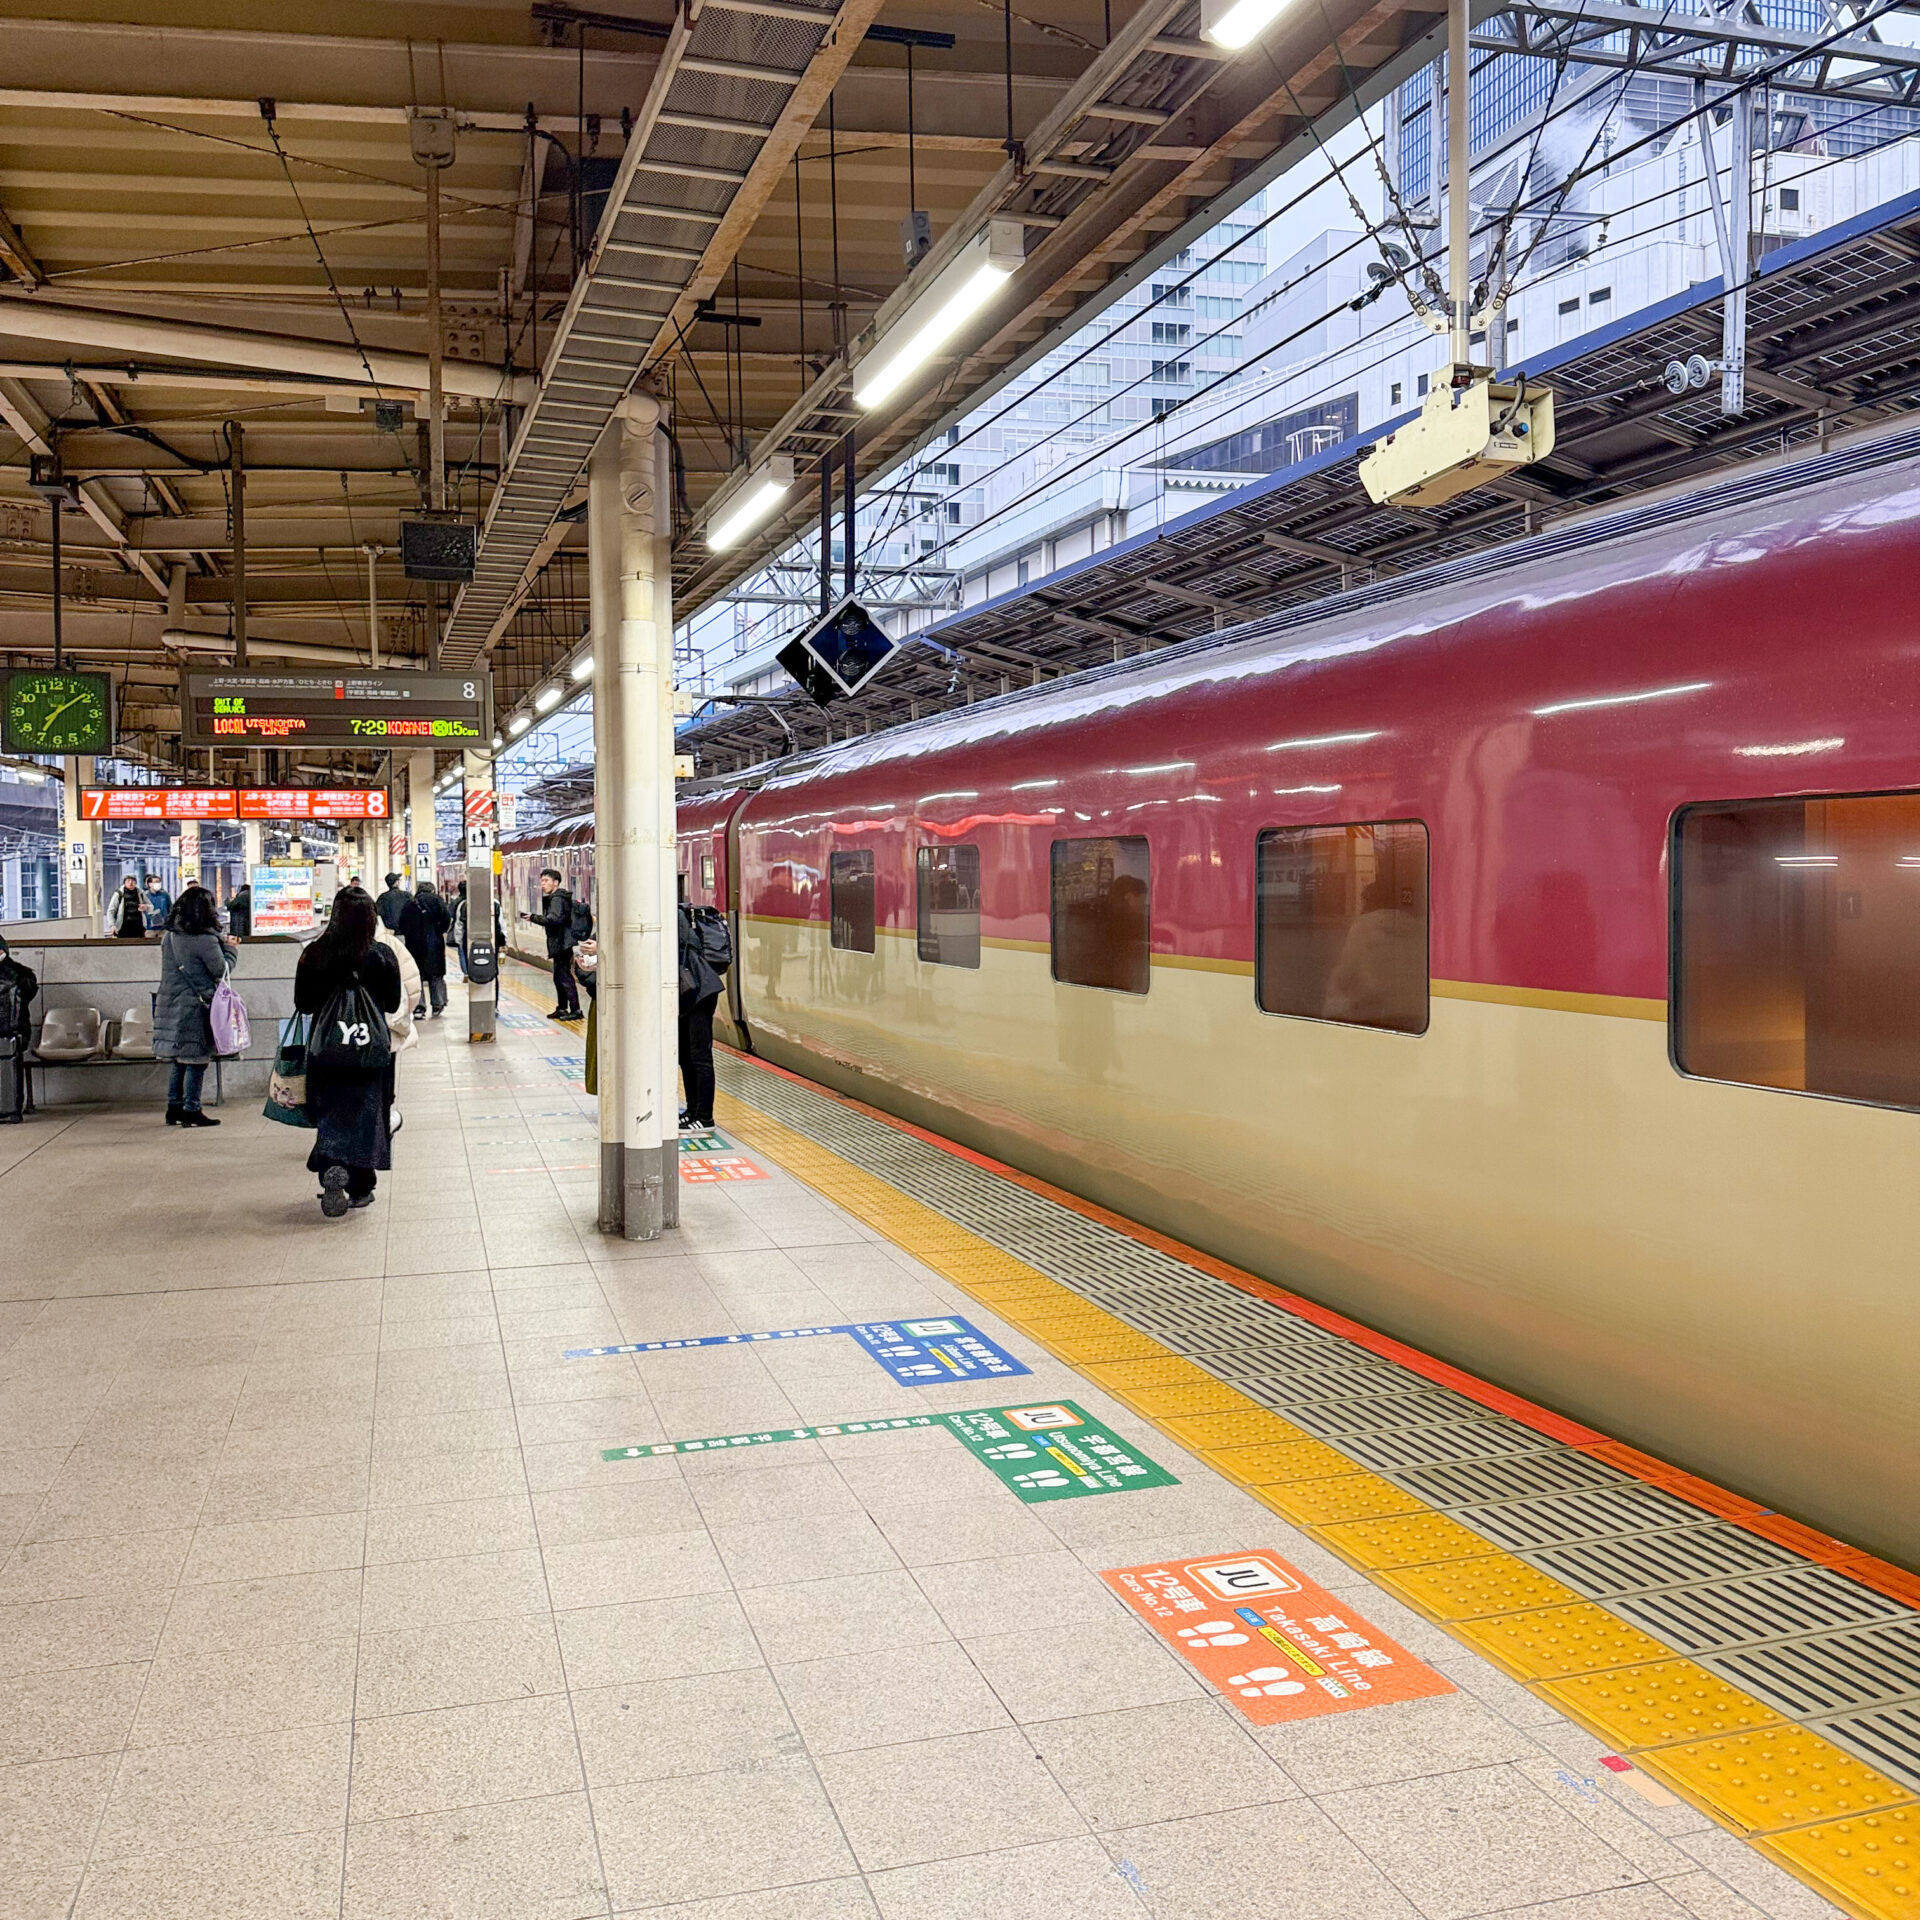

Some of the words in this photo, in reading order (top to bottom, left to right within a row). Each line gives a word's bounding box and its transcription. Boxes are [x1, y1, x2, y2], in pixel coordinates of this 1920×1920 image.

[34, 684, 47, 693] 11
[48, 680, 64, 690] 12
[70, 684, 76, 693] 1
[463, 682, 476, 698] 8
[22, 693, 36, 703] 10
[82, 694, 91, 703] 2
[214, 698, 231, 706] OUT
[233, 698, 244, 706] OF
[15, 707, 24, 716] 9
[89, 709, 98, 718] 3
[214, 706, 246, 714] SERVICE
[23, 722, 32, 732] 8
[82, 724, 92, 733] 4
[214, 719, 246, 734] LOCAL
[246, 719, 306, 728] UTSUNOMIYA
[261, 727, 290, 735] LINE
[350, 720, 387, 735] 7:29
[387, 722, 433, 735] KOGANEI
[37, 732, 46, 741] 7
[53, 736, 62, 744] 6
[68, 733, 78, 742] 5
[86, 792, 104, 816] 7
[367, 792, 384, 816] 8
[74, 844, 83, 852] 13
[419, 844, 428, 852] 13
[869, 1324, 904, 1343] 12号車
[1023, 1412, 1063, 1424] JU
[965, 1412, 1011, 1439] 12号車
[1048, 1432, 1102, 1470] Utsunomiya
[1096, 1470, 1123, 1487] Line
[1078, 1434, 1148, 1476] 宇都宮線
[1215, 1570, 1270, 1588] JU
[1119, 1573, 1144, 1592] Cars
[1138, 1592, 1174, 1617] No.12
[1140, 1569, 1208, 1613] 12号車
[1304, 1614, 1394, 1668] 高崎線
[1262, 1606, 1339, 1658] Takasaki
[1328, 1661, 1372, 1691] Line
